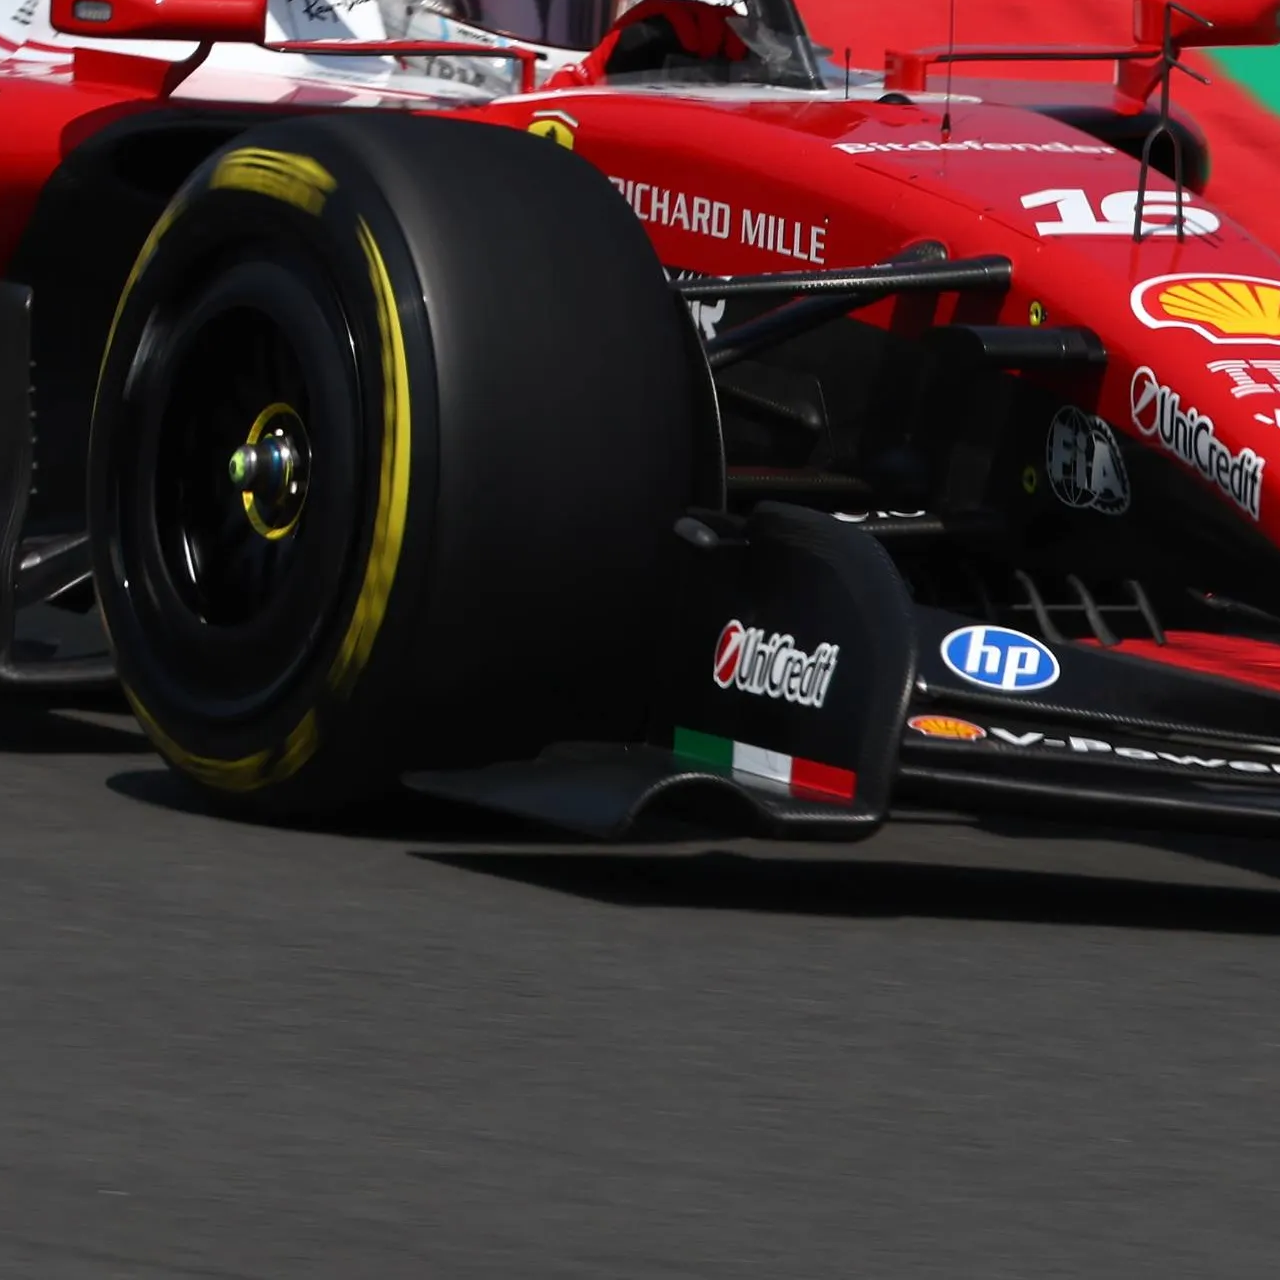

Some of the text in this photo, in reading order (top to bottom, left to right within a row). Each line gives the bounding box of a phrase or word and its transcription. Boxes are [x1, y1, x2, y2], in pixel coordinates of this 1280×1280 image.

[832, 140, 1116, 154] Bitdefender
[741, 208, 826, 264] MILLE
[1020, 188, 1220, 237] 16
[1158, 385, 1266, 521] UniCredit
[735, 626, 840, 708] UniCredit
[965, 627, 1041, 689] hp
